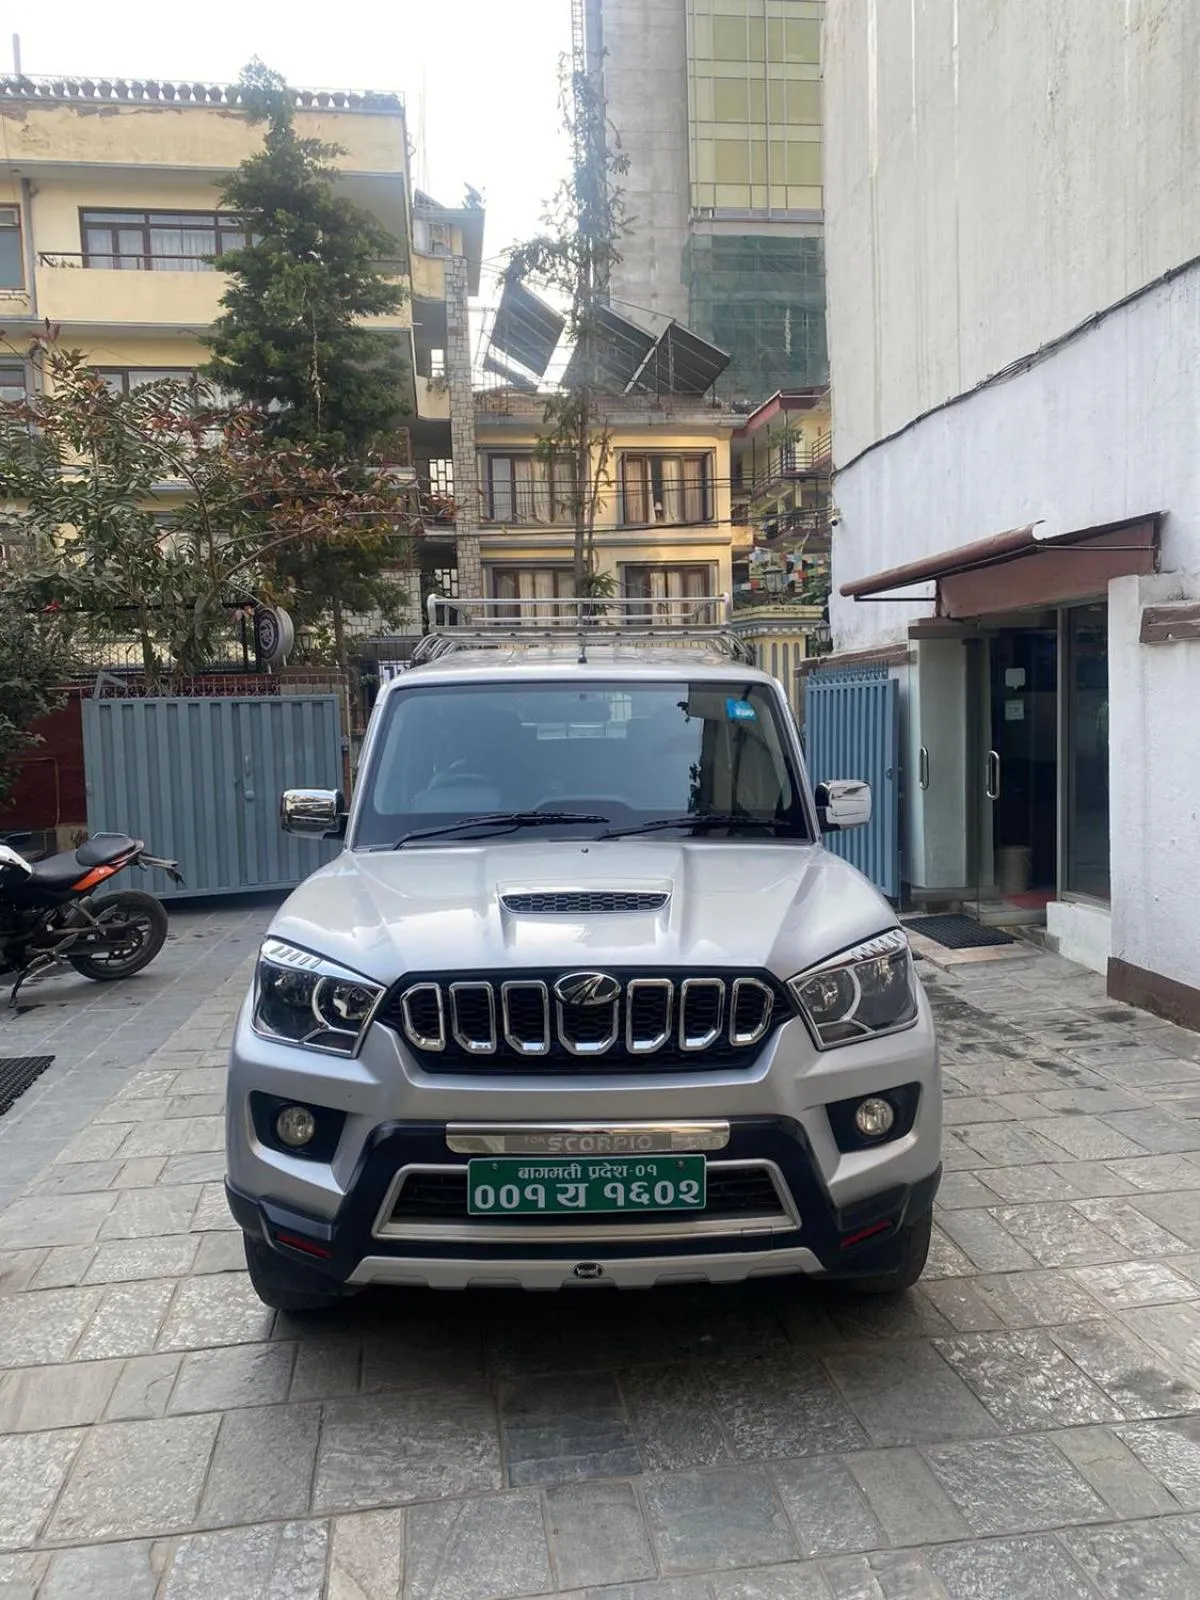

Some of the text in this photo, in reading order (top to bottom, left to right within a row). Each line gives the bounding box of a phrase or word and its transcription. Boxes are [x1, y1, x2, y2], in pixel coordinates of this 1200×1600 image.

[547, 1135, 653, 1152] SCORPIO
[518, 1163, 582, 1180] बागमती
[474, 1179, 700, 1209] ००१ य १६०२
